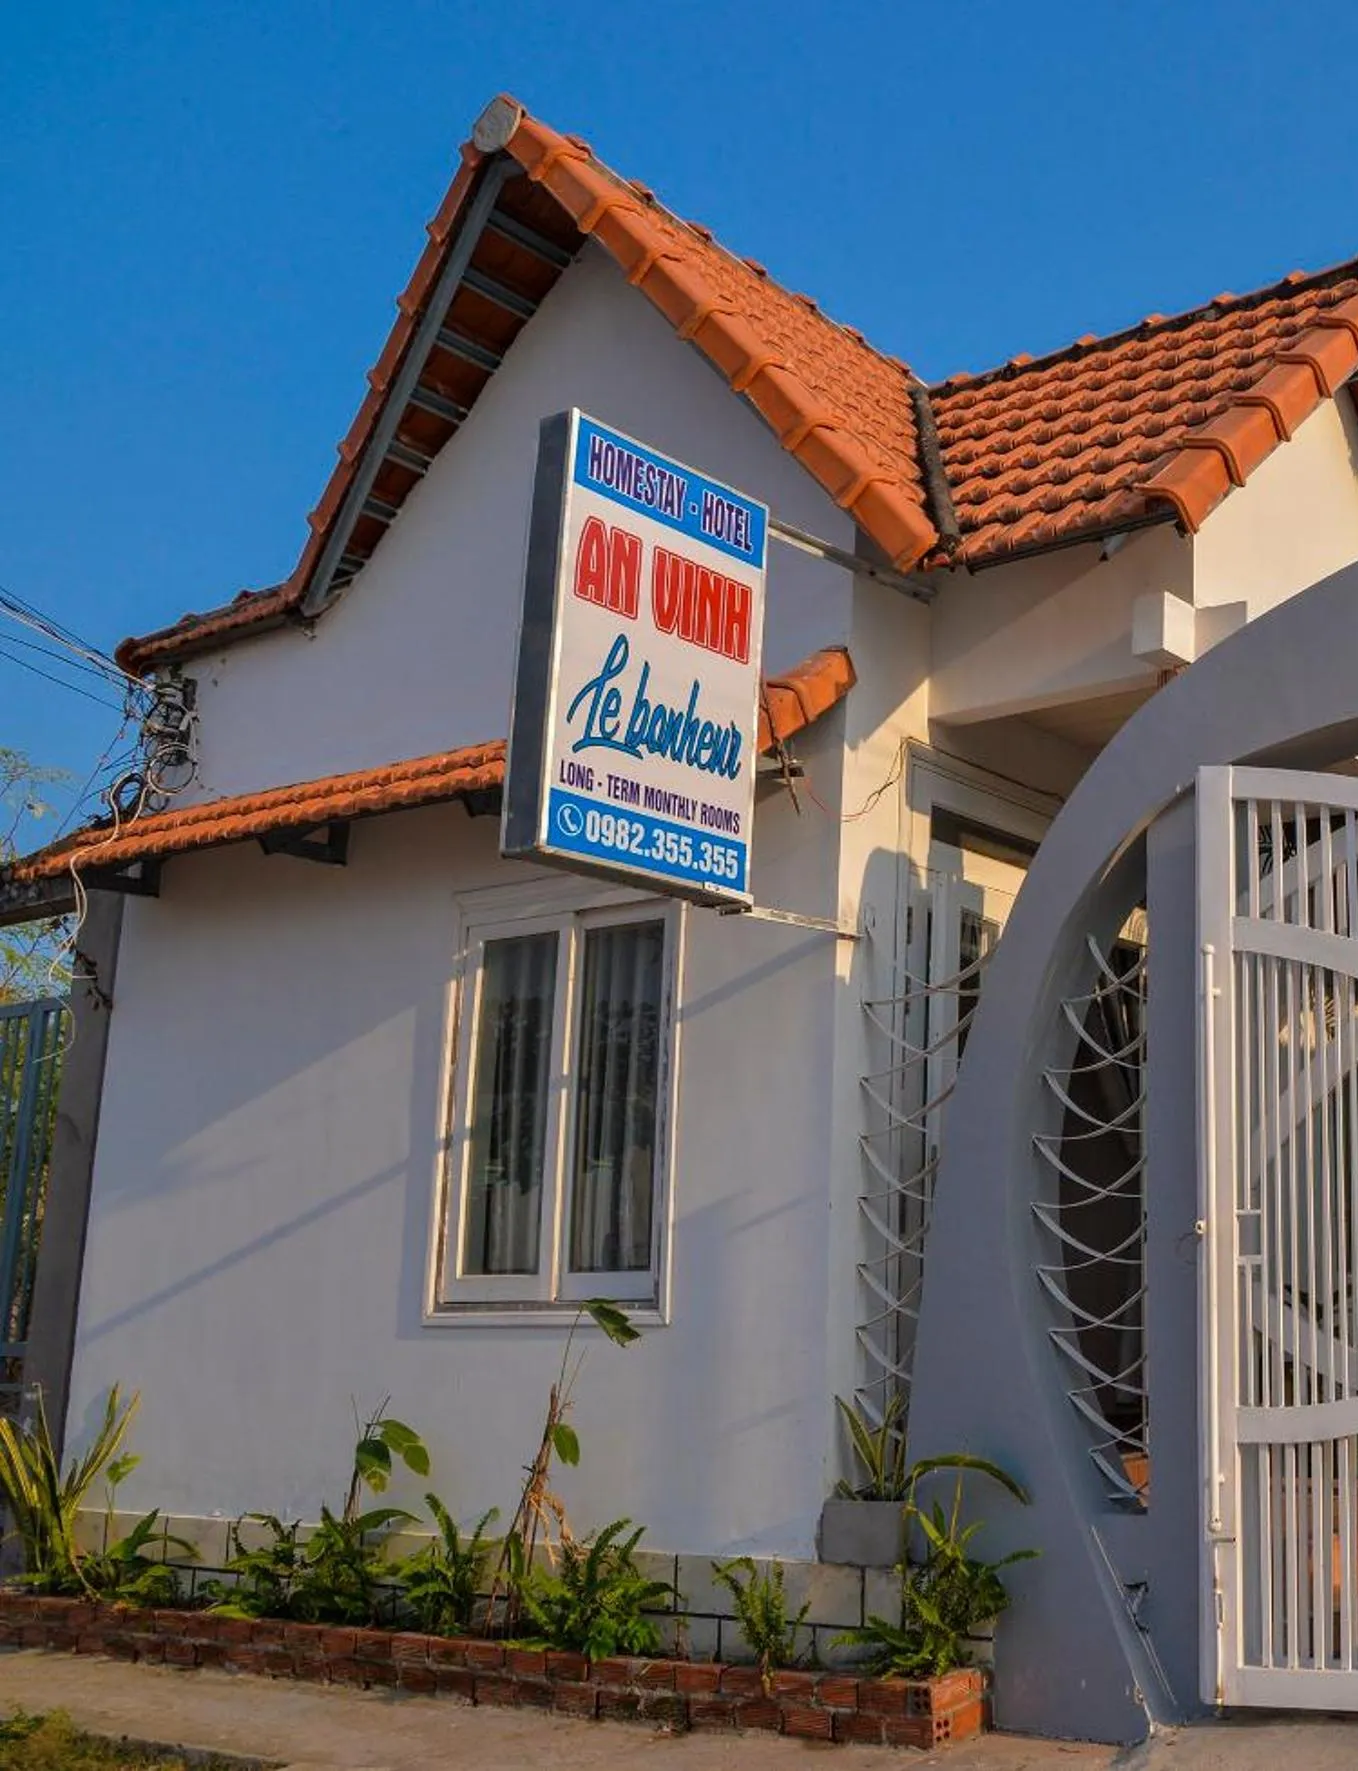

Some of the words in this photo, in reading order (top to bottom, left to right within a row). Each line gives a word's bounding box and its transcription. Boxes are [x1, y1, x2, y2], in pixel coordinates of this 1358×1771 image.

[588, 432, 687, 522] HOMESTAY
[700, 488, 753, 553] HOTEL
[574, 515, 643, 621] AN
[651, 545, 752, 664] VINH
[567, 633, 644, 760] Le
[624, 661, 744, 781] bonheur
[559, 759, 594, 792] LONG
[606, 774, 640, 806] TERM
[644, 786, 698, 823] MONTHLY
[700, 802, 740, 836] ROOMS
[584, 809, 738, 879] 0982.355.355
